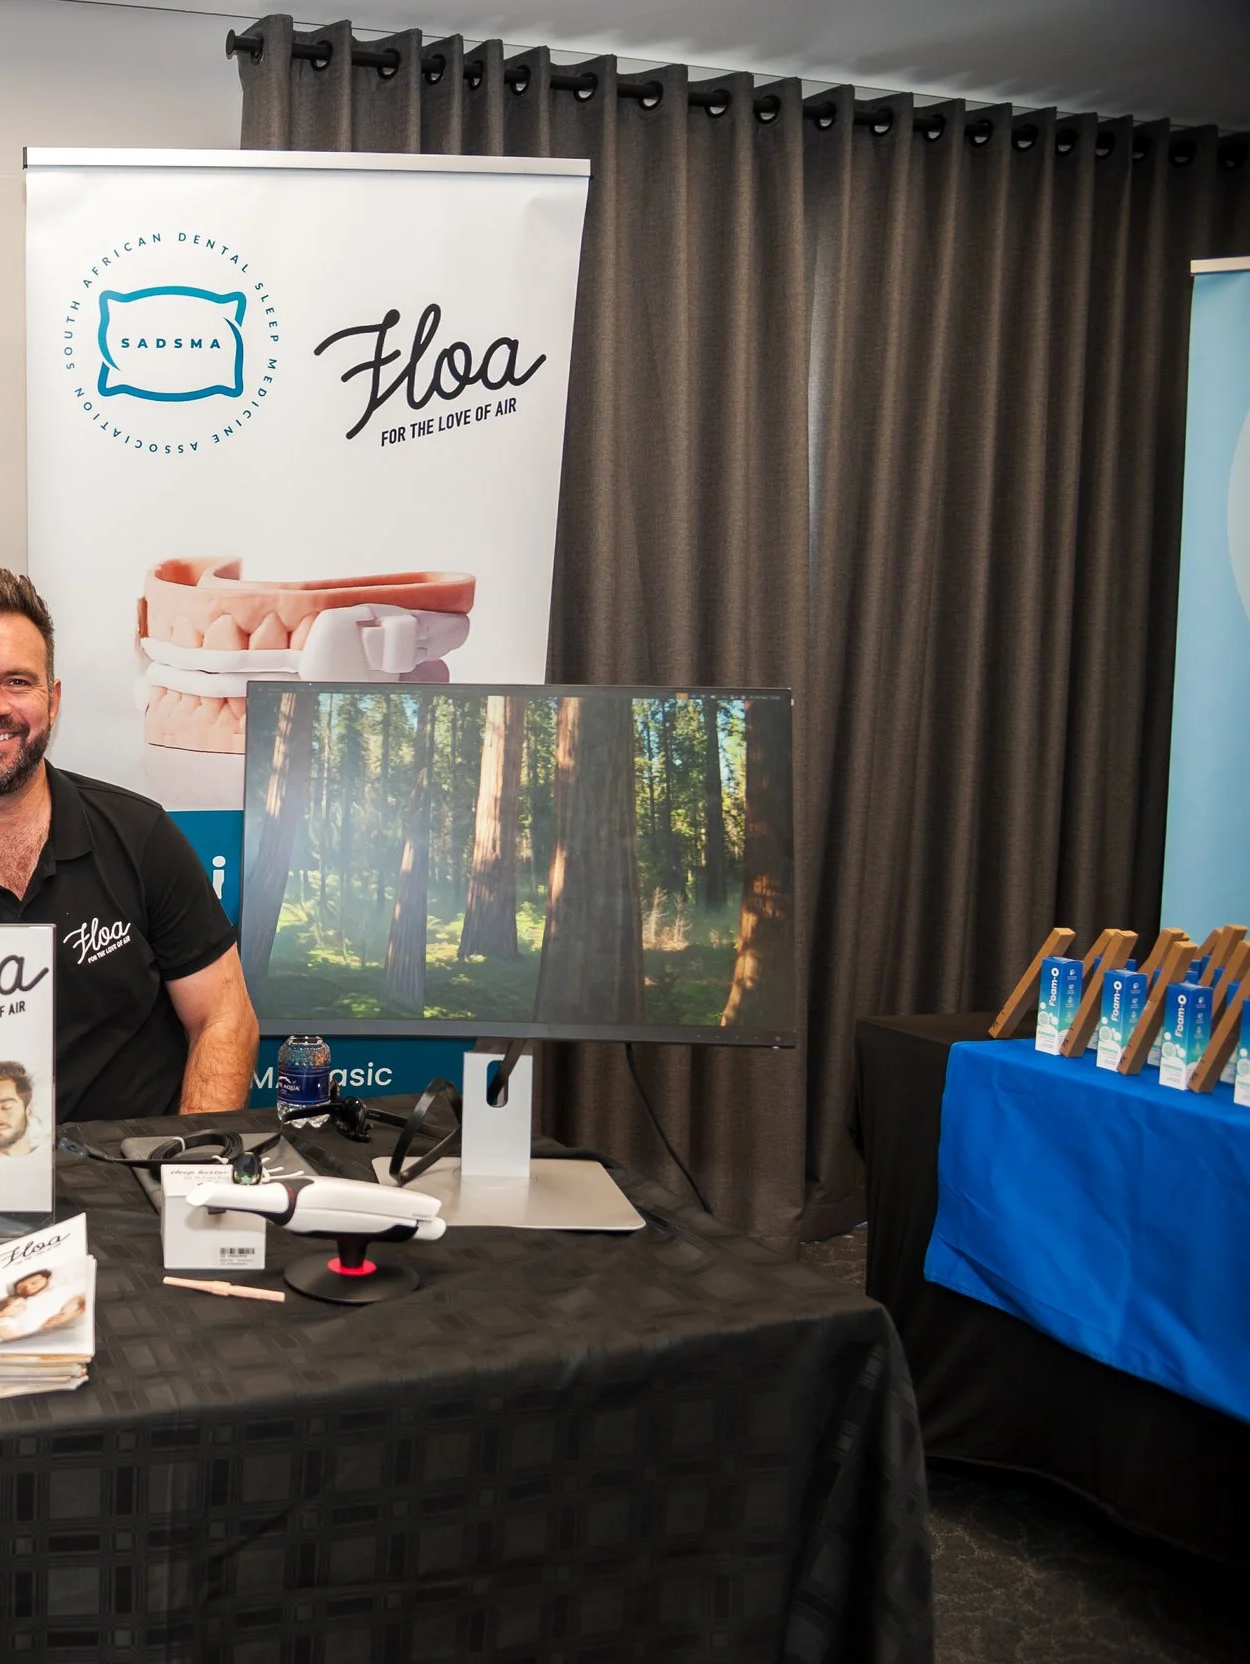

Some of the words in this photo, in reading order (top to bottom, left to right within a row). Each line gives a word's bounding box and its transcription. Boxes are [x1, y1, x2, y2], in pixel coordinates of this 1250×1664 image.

[82, 233, 162, 289] AFRICAN
[178, 232, 249, 274] DENTAL
[64, 300, 81, 370] SOUTH
[254, 282, 280, 344] SLEEP
[120, 337, 222, 350] SADSMA
[313, 303, 547, 440] Floa
[74, 387, 198, 455] ASSOCIATION
[211, 357, 278, 444] MEDICINE
[381, 428, 406, 447] FOR
[410, 419, 434, 440] THE
[438, 411, 471, 433] LOVE
[475, 405, 492, 422] OF
[495, 397, 517, 417] AIR
[63, 917, 132, 965] Floa
[8, 1001, 26, 1014] AIR
[329, 1061, 393, 1087] asic
